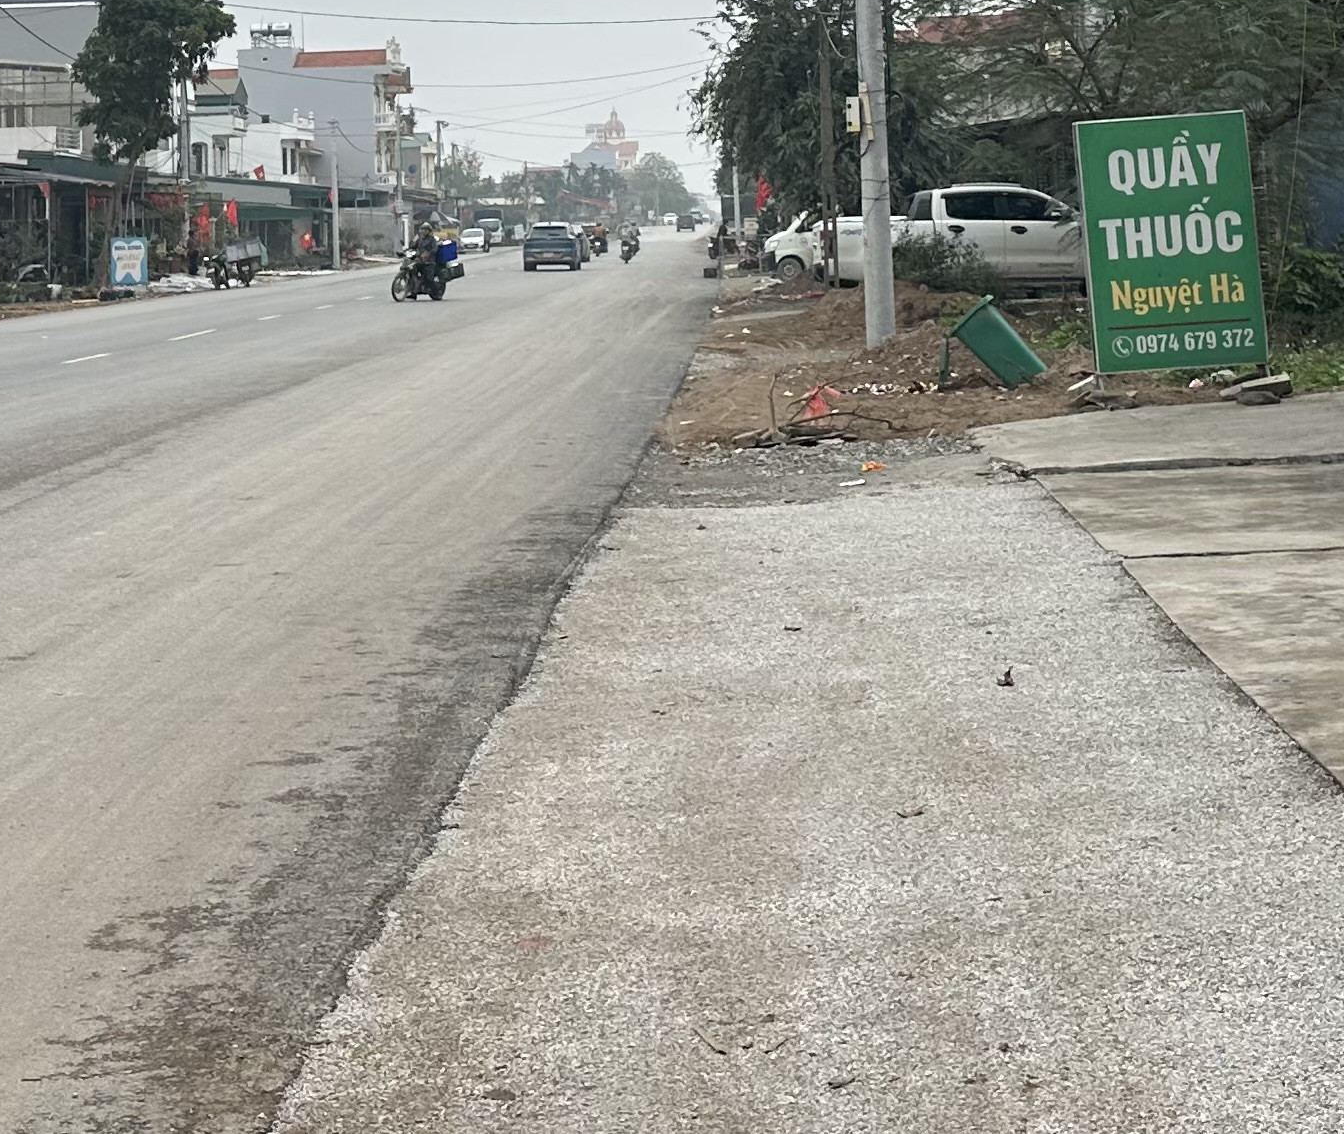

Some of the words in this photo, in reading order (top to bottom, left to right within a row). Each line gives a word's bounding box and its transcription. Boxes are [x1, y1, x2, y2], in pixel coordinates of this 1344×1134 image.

[1108, 130, 1222, 196] QUẦY
[1099, 197, 1244, 260] THUỐC
[1110, 278, 1203, 315] Nguyệt
[1209, 273, 1245, 304] Hà
[1136, 334, 1179, 355] 0974
[1184, 331, 1217, 351] 679
[1222, 328, 1256, 349] 372
